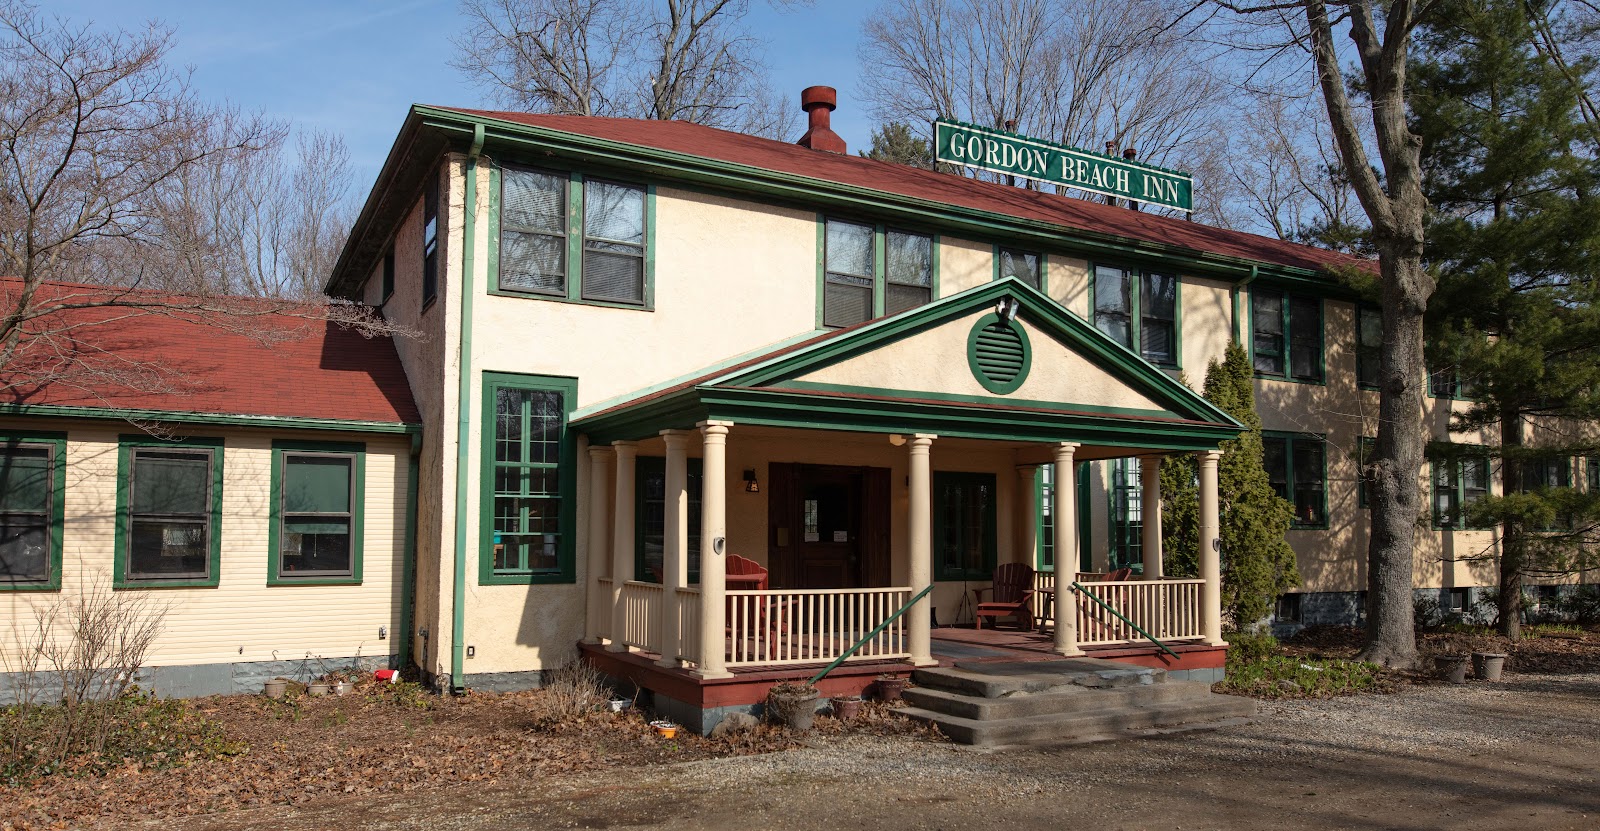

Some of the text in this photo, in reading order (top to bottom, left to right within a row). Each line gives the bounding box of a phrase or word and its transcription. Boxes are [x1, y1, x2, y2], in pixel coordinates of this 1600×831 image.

[950, 132, 1179, 203] GORDON BEACH INN
